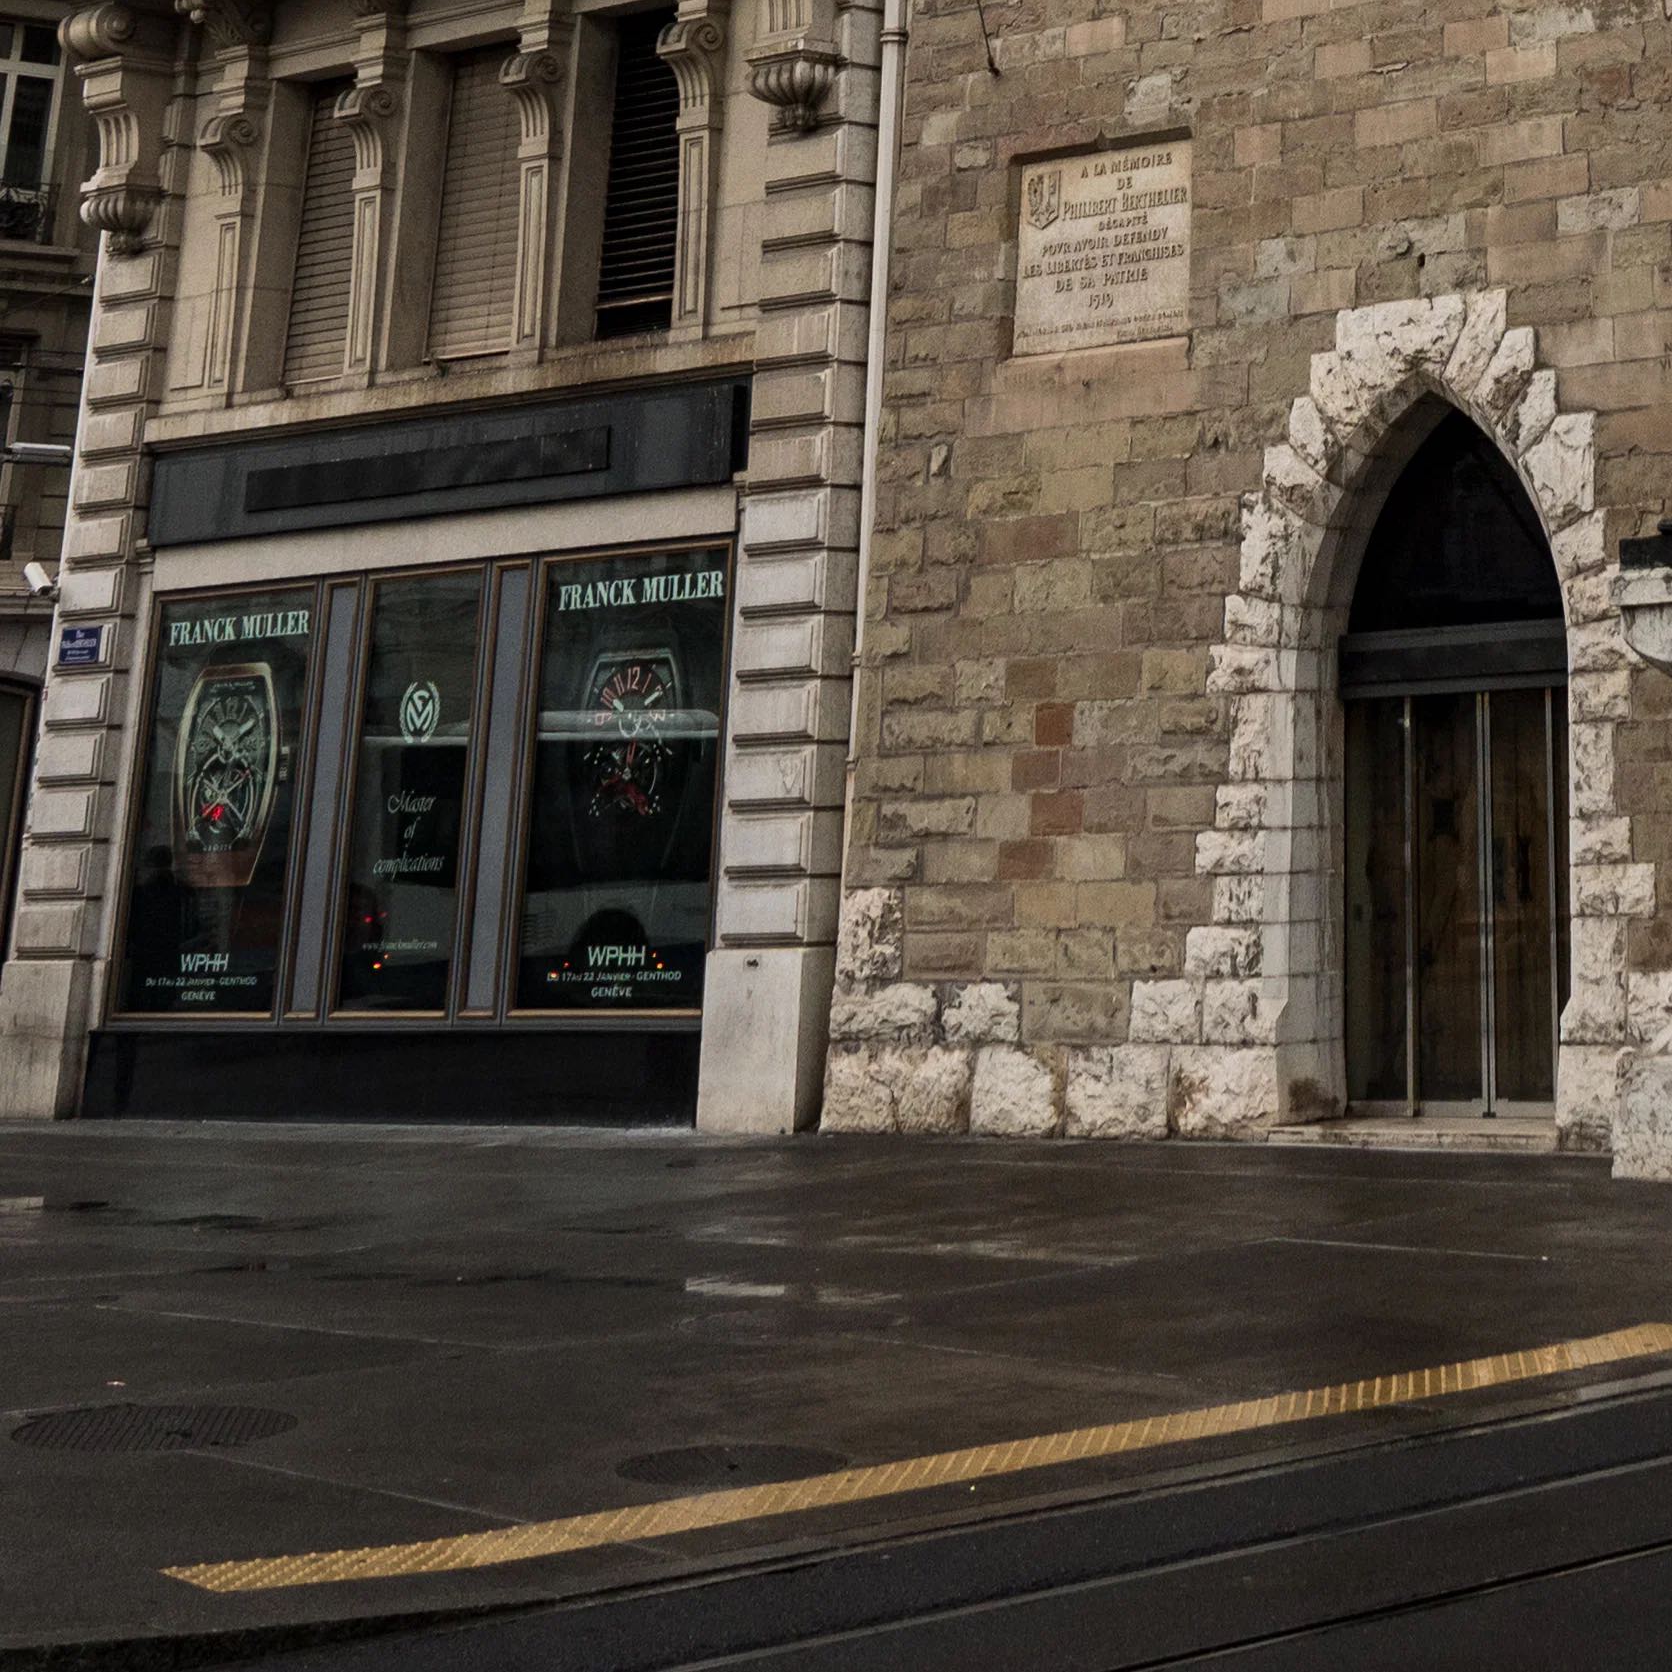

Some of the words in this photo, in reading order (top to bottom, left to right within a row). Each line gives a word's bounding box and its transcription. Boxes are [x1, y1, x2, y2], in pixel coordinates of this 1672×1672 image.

[1081, 166, 1088, 179] A
[1094, 163, 1107, 177] LA
[1110, 152, 1173, 175] MÉMOIRE
[1117, 176, 1133, 190] DE
[1062, 197, 1117, 221] PHILIBERT
[1120, 186, 1188, 213] BERTHELIER
[1098, 211, 1148, 232] DÉCAPITÉ
[1074, 237, 1109, 253] AVOIR
[1022, 264, 1043, 279] LES
[1046, 254, 1097, 275] LIBERTÉS
[1101, 253, 1115, 268] ET
[1117, 244, 1185, 266] FRANCHISES
[1055, 277, 1073, 294] DE
[1080, 275, 1096, 290] SA
[1102, 268, 1149, 287] PATRIE
[1088, 293, 1114, 310] 1519
[558, 578, 636, 611] FRANCK
[641, 570, 724, 604] MULLER
[169, 616, 236, 646] FRANCK
[240, 610, 309, 640] MULLER
[387, 790, 437, 814] Master
[404, 816, 422, 848] of
[373, 850, 446, 882] complications
[181, 953, 230, 972] WPHH
[588, 945, 646, 966] WPHH
